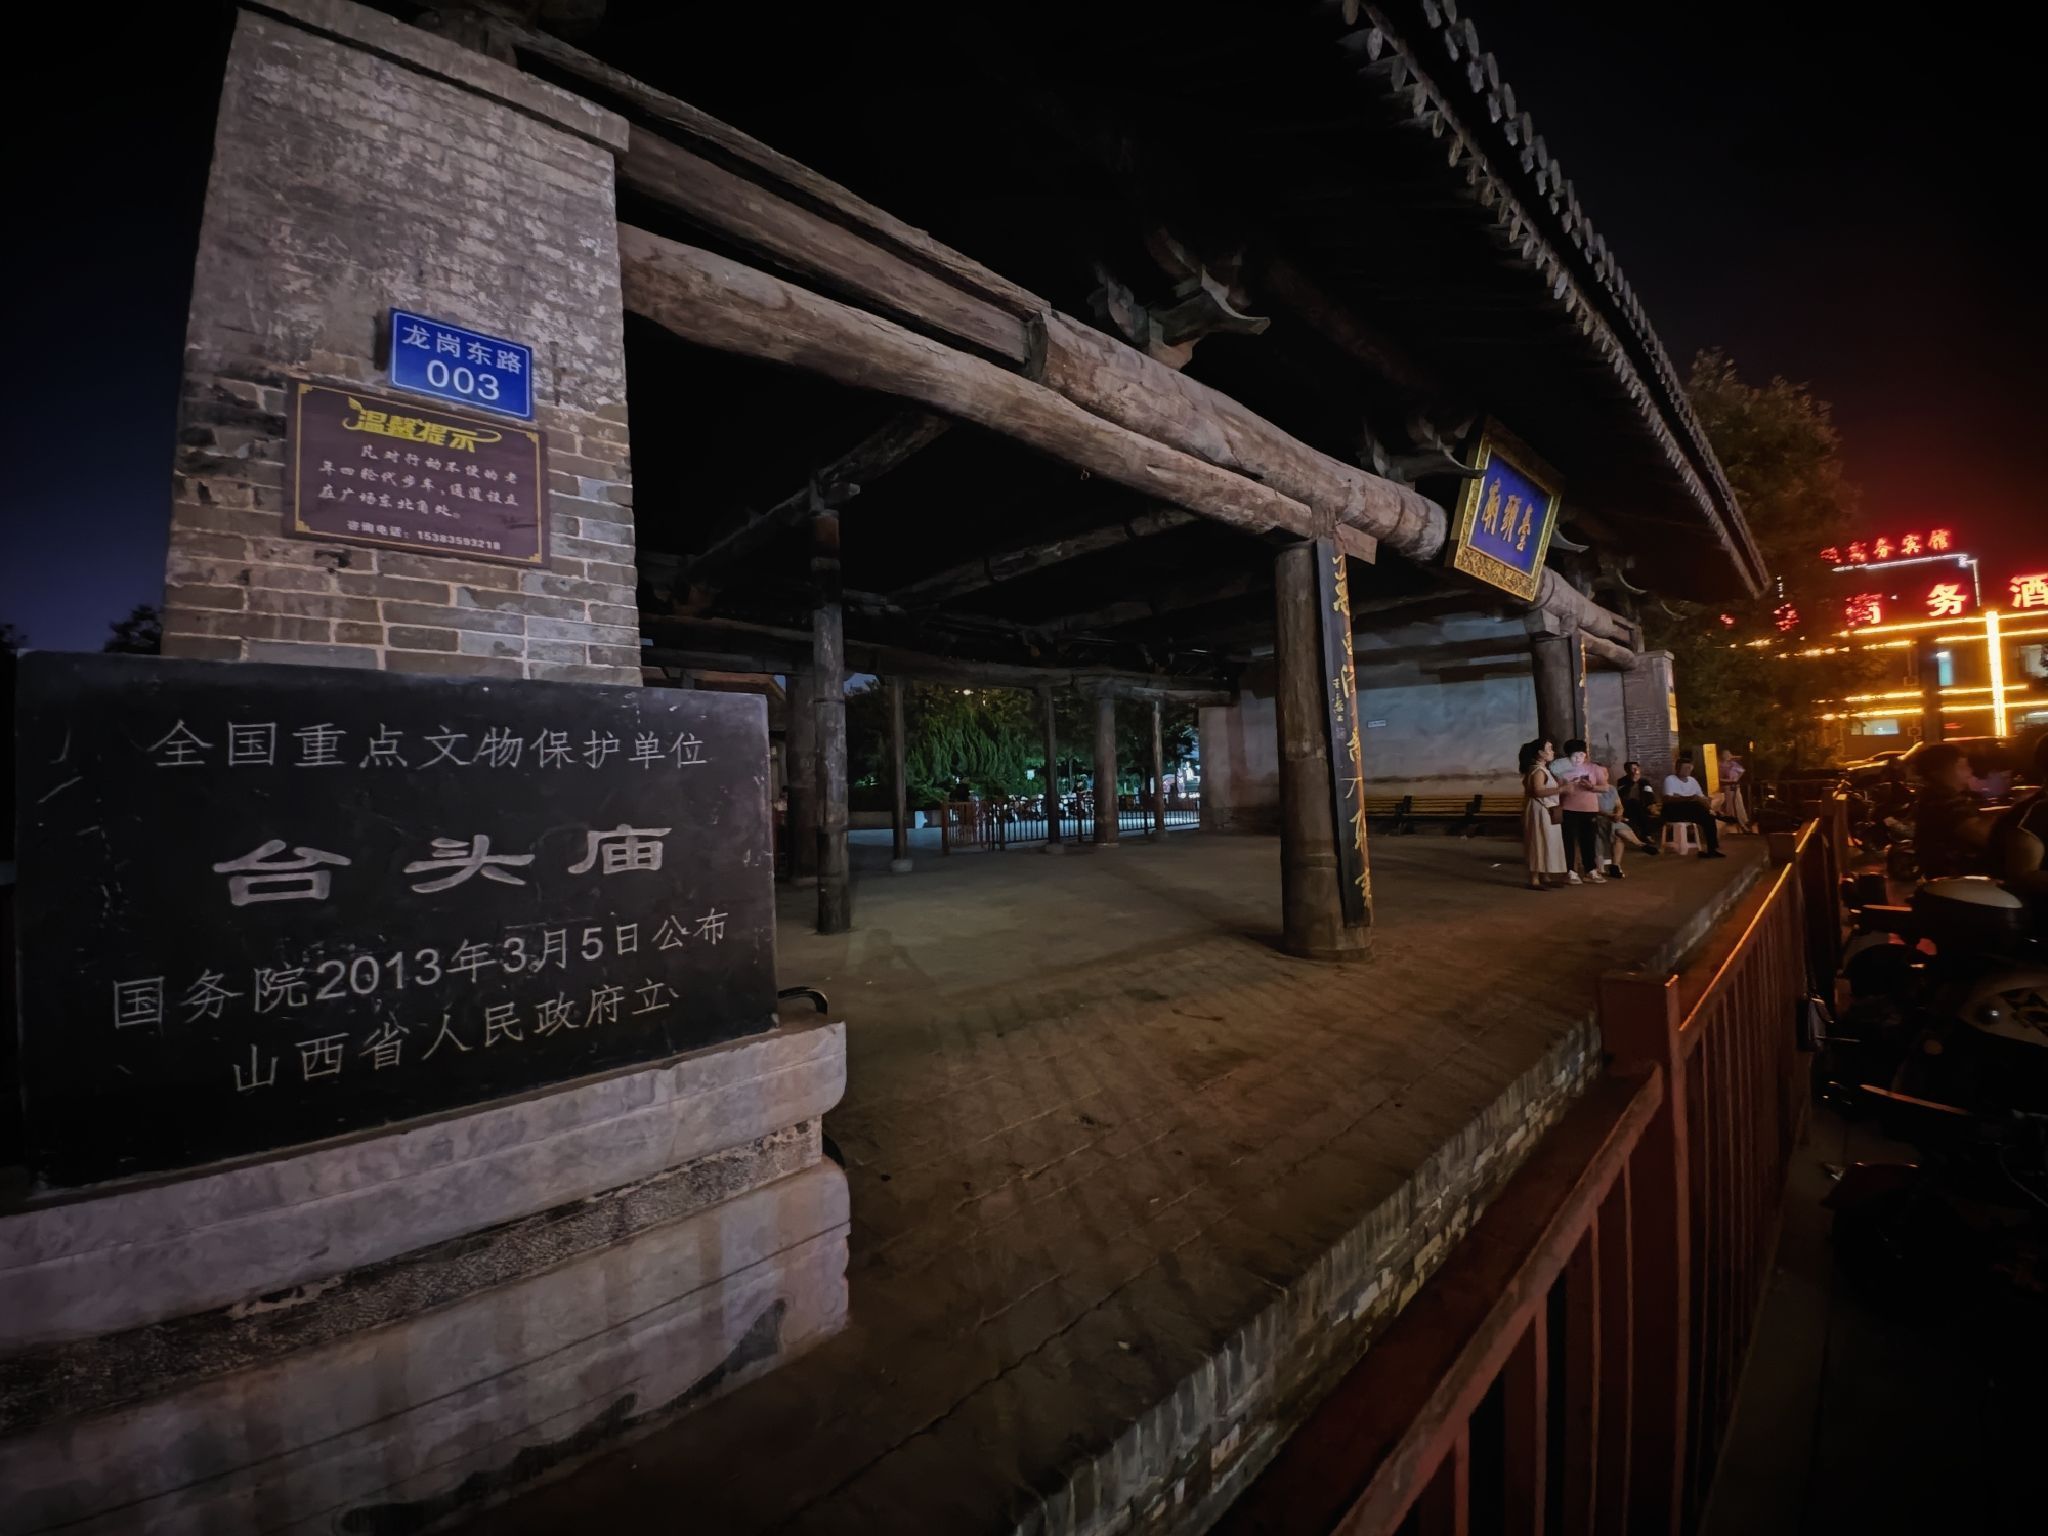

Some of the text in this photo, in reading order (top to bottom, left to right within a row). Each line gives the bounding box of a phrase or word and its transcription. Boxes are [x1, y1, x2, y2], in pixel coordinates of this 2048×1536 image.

[402, 324, 523, 376] 龙岗东路
[426, 359, 501, 401] 003
[354, 405, 480, 453] 温馨提示
[147, 717, 709, 772] 全国重点文物保护单位
[212, 823, 673, 907] 台头庙
[112, 907, 729, 1030] 国务院2013年3月5日公布
[232, 976, 680, 1095] 山西省人民政府立
